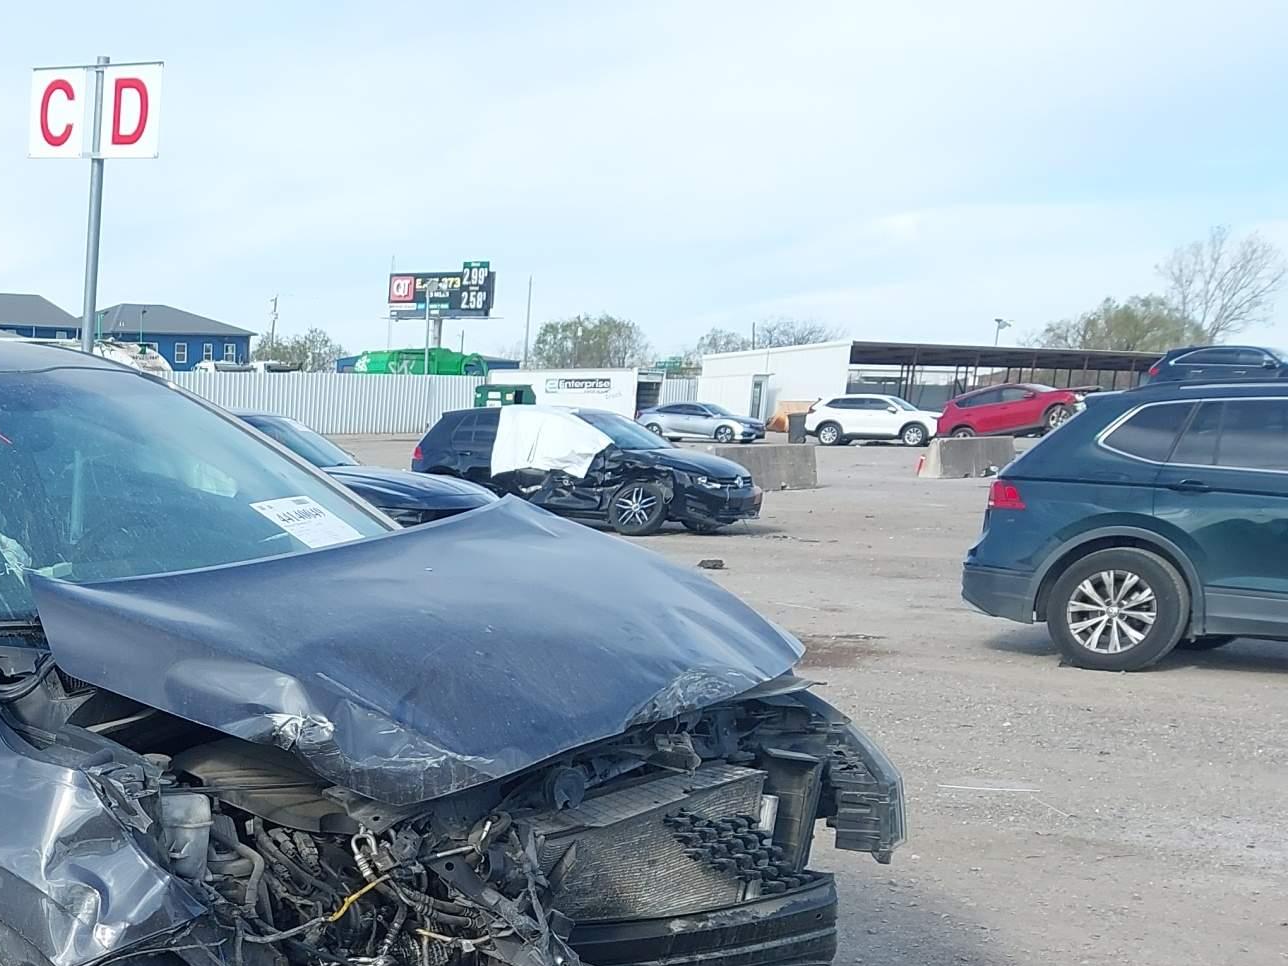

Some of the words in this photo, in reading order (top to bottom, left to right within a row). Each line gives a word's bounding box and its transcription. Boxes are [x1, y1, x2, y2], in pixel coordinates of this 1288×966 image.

[40, 79, 75, 147] C
[112, 78, 149, 145] D
[559, 380, 611, 389] Enterprise
